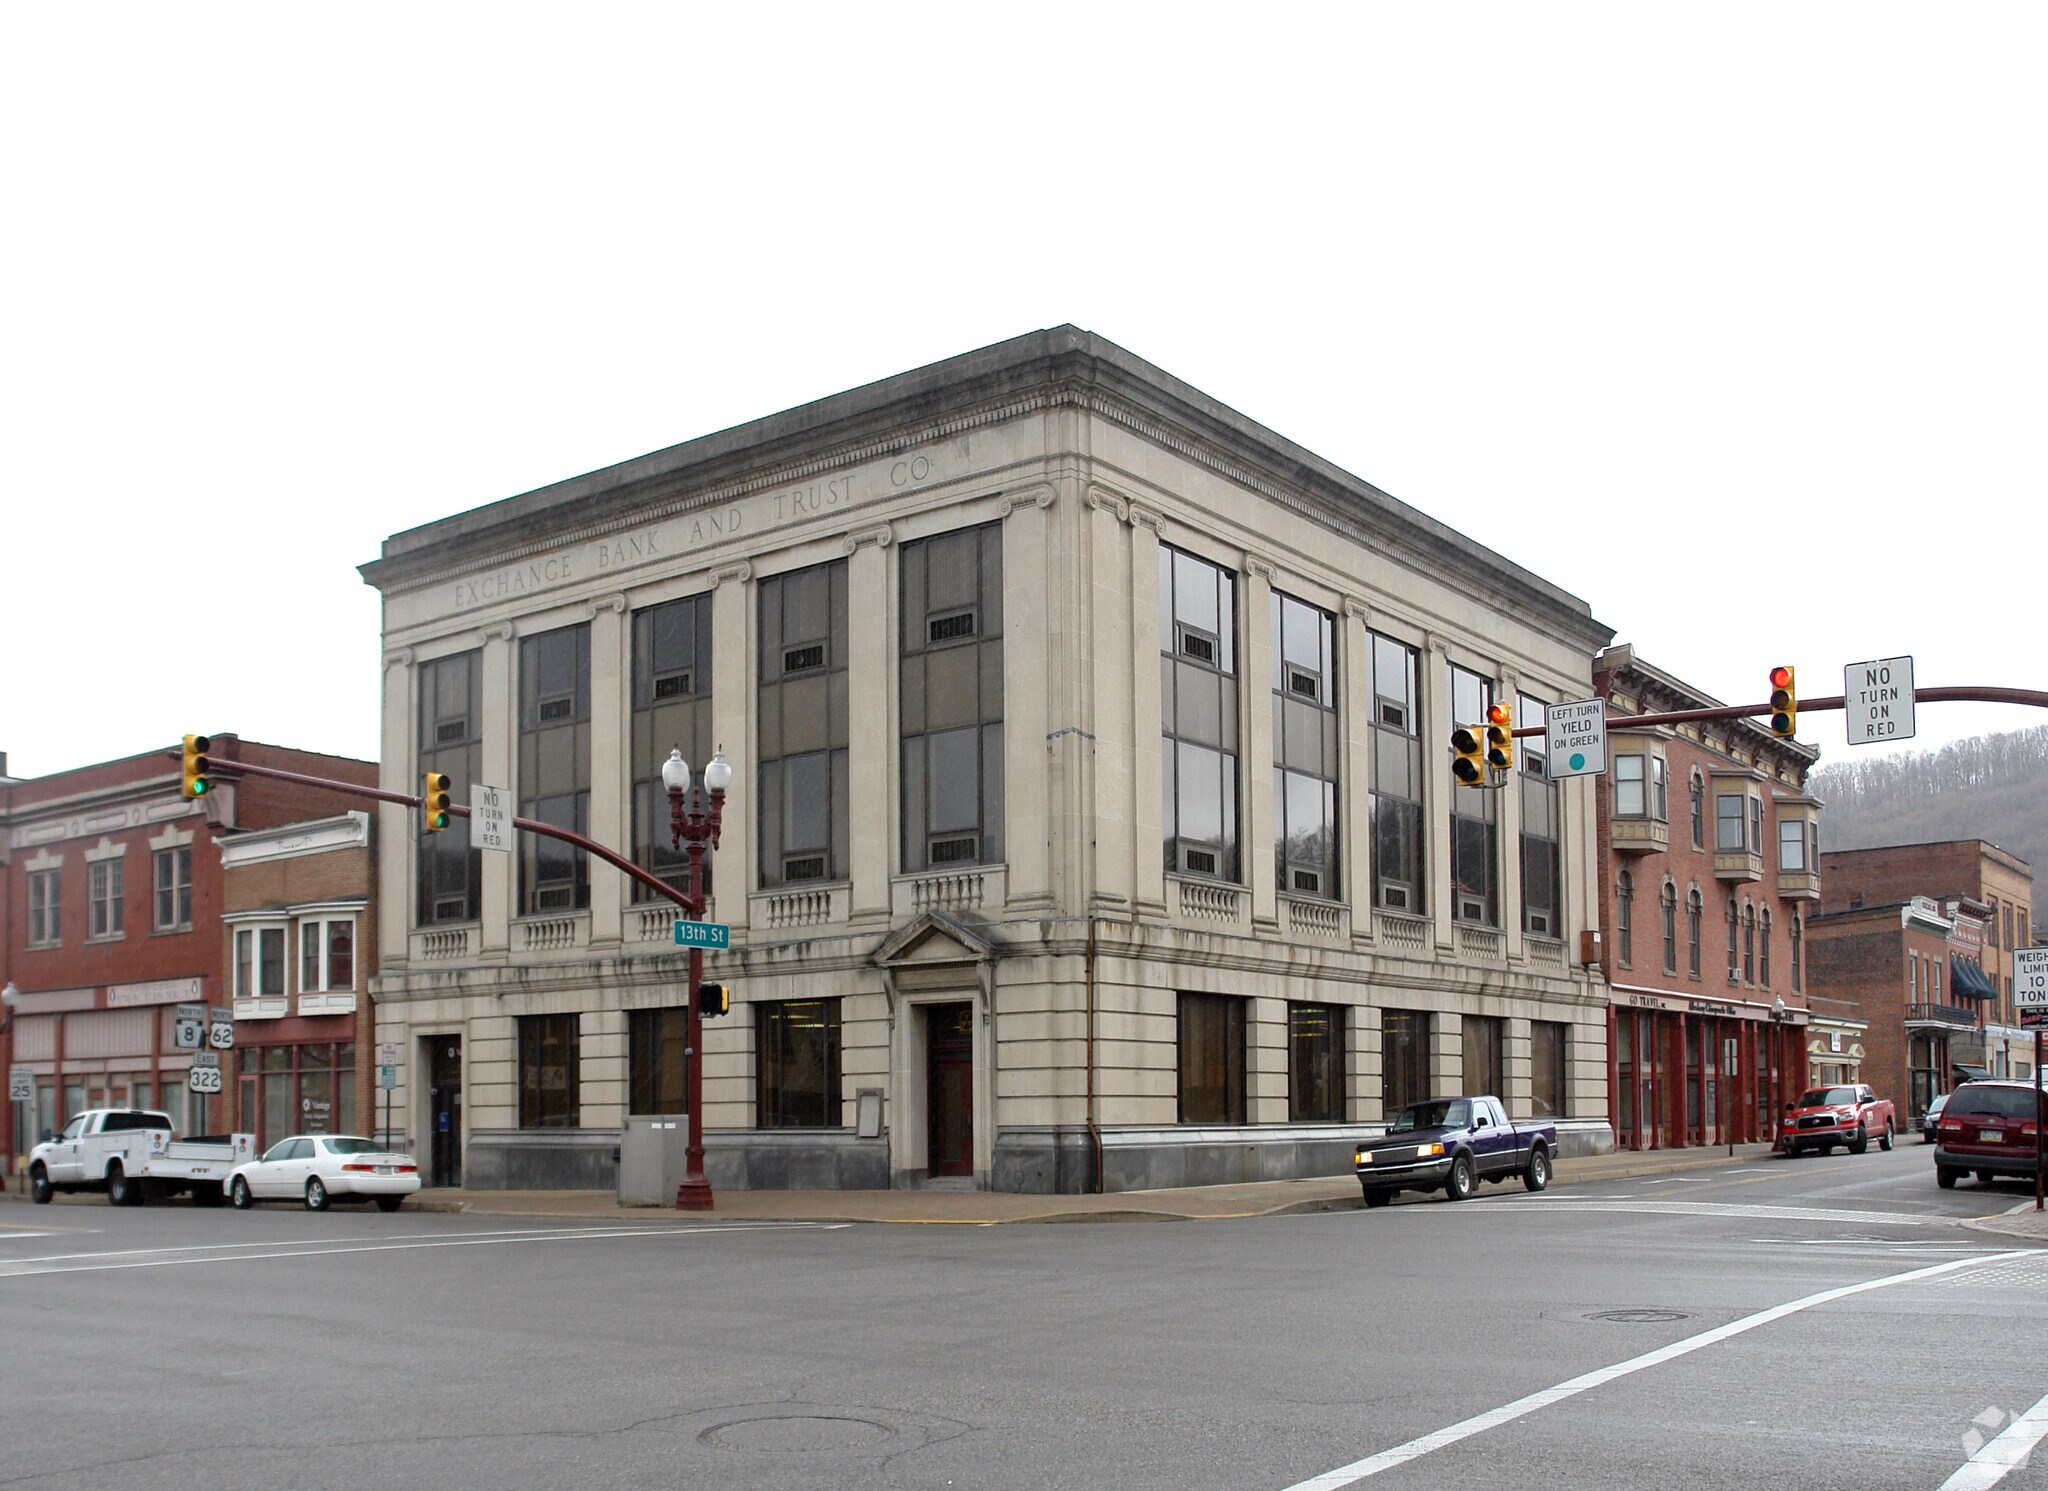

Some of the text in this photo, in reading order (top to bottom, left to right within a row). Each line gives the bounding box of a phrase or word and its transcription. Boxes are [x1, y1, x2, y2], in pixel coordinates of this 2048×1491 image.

[455, 555, 571, 606] EXCHANGE
[599, 530, 659, 568] BANK
[689, 508, 742, 543] AND
[773, 476, 856, 519] TRUST
[1867, 667, 1890, 686] NO
[1860, 687, 1898, 704] TURN
[1552, 705, 1599, 720] LEFT TURN
[1870, 705, 1889, 719] ON
[1561, 720, 1591, 734] YIELD
[1867, 721, 1895, 736] RED
[1554, 735, 1599, 749] ON GREEN
[484, 792, 499, 806] NO
[480, 807, 503, 821] TURN
[485, 821, 498, 833] ON
[483, 834, 501, 846] RED
[681, 925, 723, 942] 13th St
[2029, 976, 2045, 988] 10
[1629, 995, 1638, 1005] GO
[2020, 991, 2048, 1002] TON
[179, 1006, 201, 1016] NORTH
[212, 1010, 232, 1019] NORTH
[184, 1027, 194, 1042] 8
[213, 1028, 231, 1044] 62
[196, 1053, 215, 1063] EAST
[192, 1072, 219, 1088] 322
[12, 1085, 30, 1097] 25
